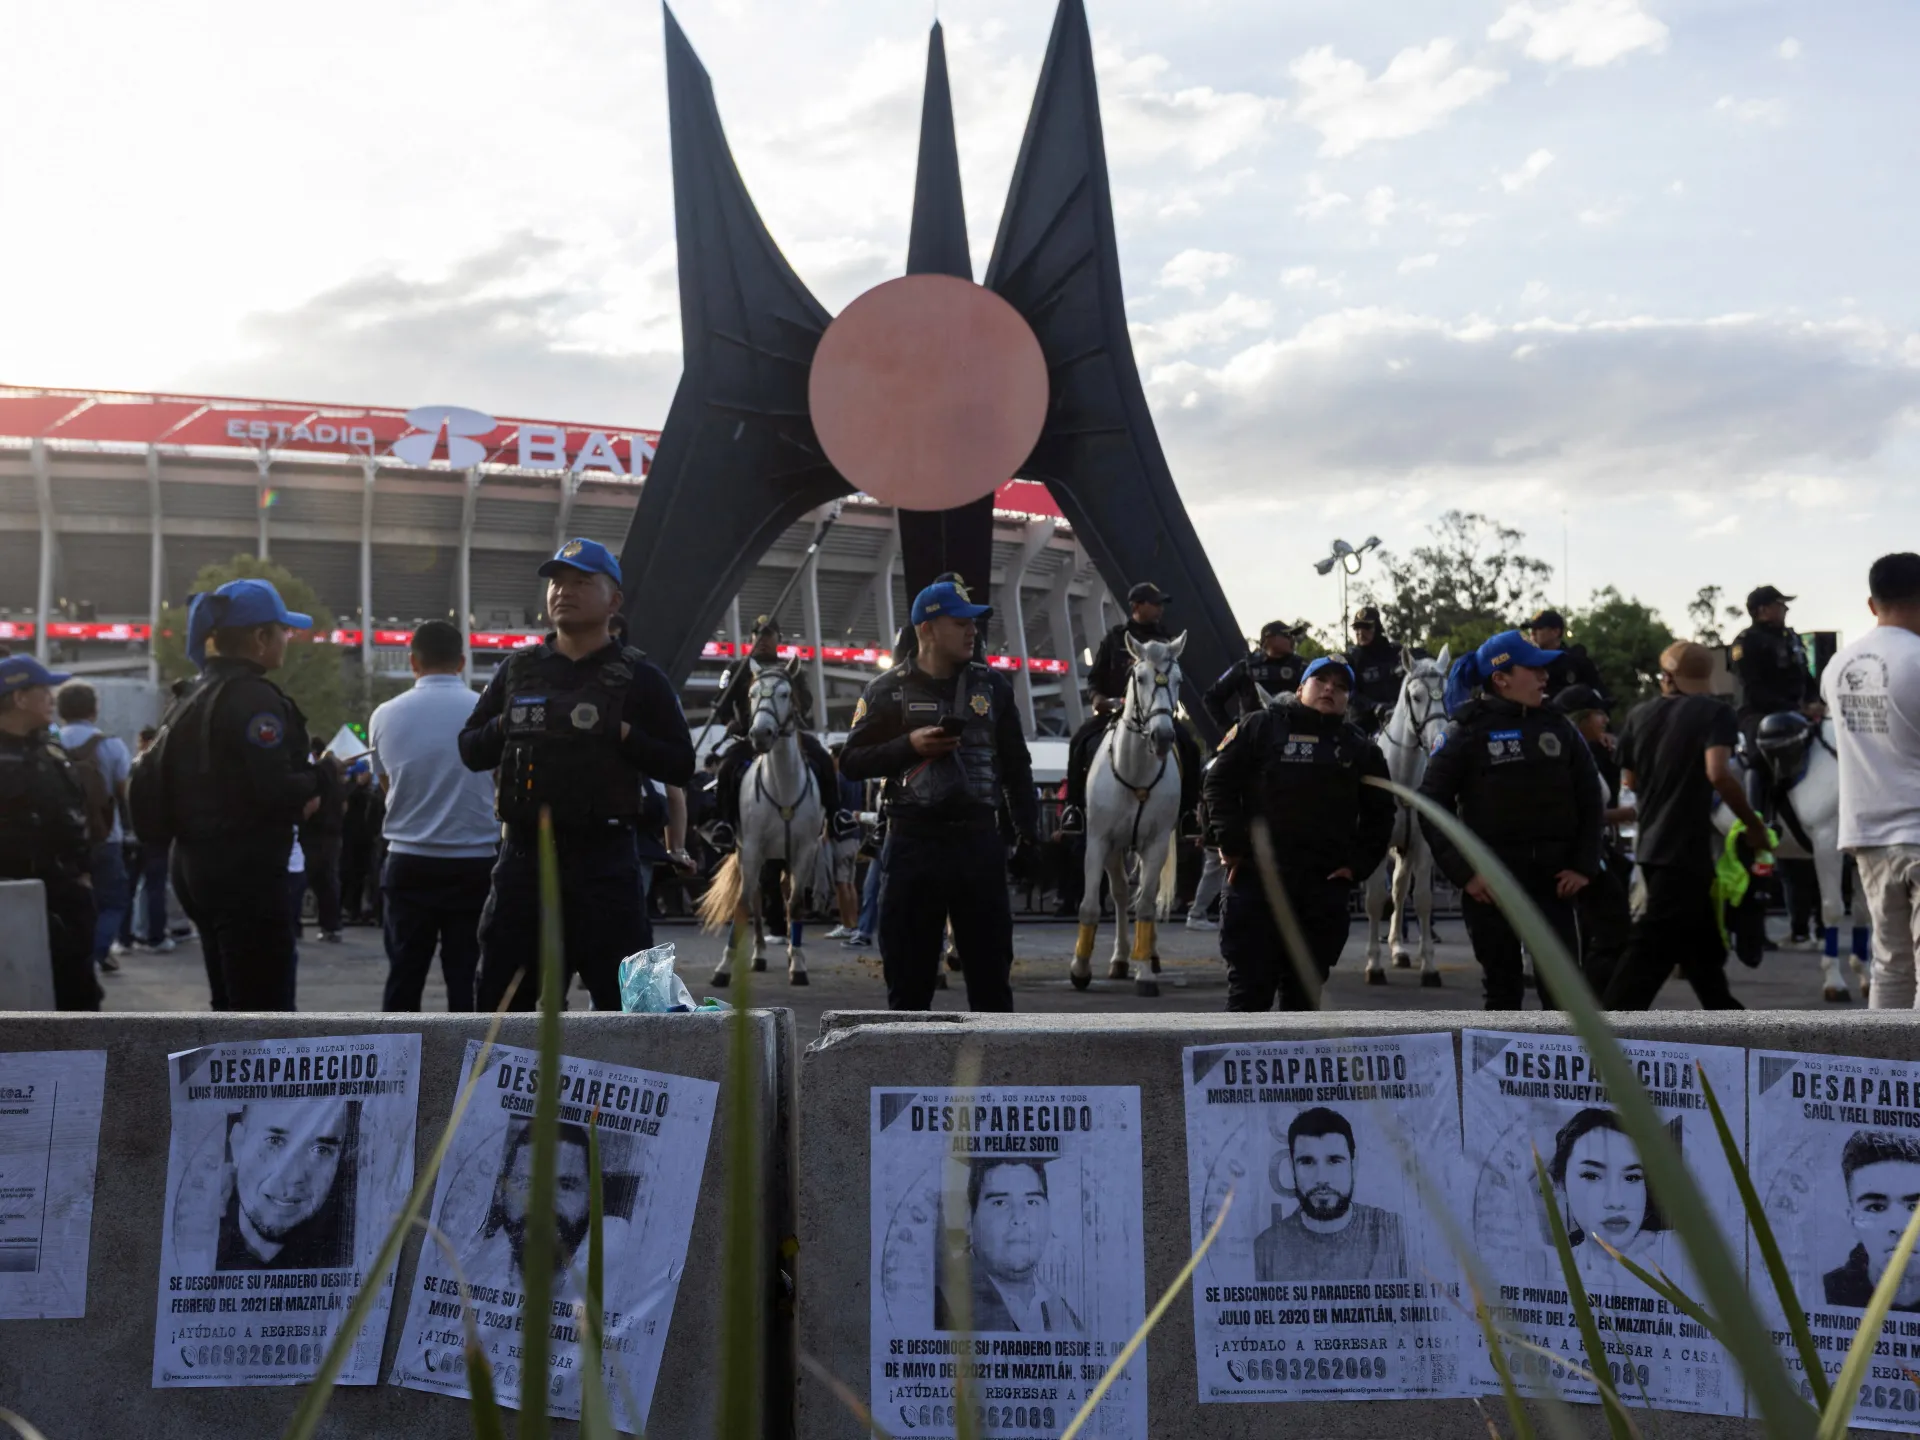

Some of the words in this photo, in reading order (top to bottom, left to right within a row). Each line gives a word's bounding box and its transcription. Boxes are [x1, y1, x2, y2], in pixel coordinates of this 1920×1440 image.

[226, 418, 375, 447] ESTADIO
[221, 1048, 236, 1057] NOS
[243, 1047, 271, 1056] FALTAS
[296, 1046, 310, 1054] NOS
[316, 1045, 345, 1053] FALTAN
[350, 1043, 375, 1051] TODOS
[1257, 1048, 1288, 1056] FALTAS
[1315, 1046, 1332, 1054] NOS
[1336, 1045, 1368, 1054] FALTAN
[1373, 1044, 1400, 1052] TODOS
[1516, 1041, 1534, 1049] NOS
[1539, 1042, 1573, 1052] FALTAS
[1662, 1050, 1690, 1060] TODOS
[210, 1054, 378, 1083] DESAPARECIDO
[514, 1056, 529, 1064] NOS
[588, 1068, 603, 1078] NOS
[608, 1072, 639, 1084] FALTAN
[642, 1078, 669, 1089] TODOS
[1224, 1055, 1408, 1086] DESAPARECIDO
[1505, 1051, 1694, 1090] DESAPACIDA
[1804, 1062, 1822, 1070] NOS
[1828, 1064, 1862, 1074] FALTAS
[188, 1086, 210, 1100] LUIS
[214, 1084, 268, 1099] HUMBERTO
[271, 1083, 336, 1098] VALDELAMAR
[338, 1080, 404, 1097] BUSTAMANTE
[497, 1064, 670, 1118] DESPARECIDO
[1002, 1094, 1018, 1102] NOS
[1024, 1094, 1056, 1102] FALTAN
[1060, 1094, 1088, 1102] TODOS
[1207, 1086, 1256, 1105] MISRAEL
[1259, 1086, 1314, 1104] ARMANDO
[1316, 1083, 1378, 1102] SEPÚLVEDA
[1500, 1079, 1550, 1099] YAJAIRA
[1553, 1084, 1590, 1102] SUJEY
[1645, 1089, 1708, 1110] ERNÁNDEZ
[500, 1093, 534, 1114] CÉSAR
[584, 1108, 631, 1132] BRTOLDI
[632, 1118, 660, 1137] PÁEZ
[911, 1106, 1093, 1132] DESAPARECIDO
[1803, 1100, 1835, 1121] SAÚL
[1838, 1104, 1870, 1124] YAEL
[952, 1136, 980, 1152] ALEX
[984, 1132, 1026, 1153] PELÁEZ
[1030, 1136, 1058, 1152] SOTO
[169, 1277, 182, 1291] SE
[185, 1276, 245, 1291] DESCONOCE
[247, 1276, 261, 1290] SU
[263, 1274, 318, 1290] PARADERO
[424, 1276, 438, 1292] SE
[501, 1291, 516, 1308] SU
[1206, 1287, 1220, 1303] SE
[1223, 1286, 1290, 1302] DESCONOCE
[1293, 1285, 1308, 1302] SU
[1310, 1284, 1371, 1300] PARADERO
[1374, 1283, 1410, 1300] DESDE
[171, 1298, 216, 1313] FEBRERO
[219, 1298, 237, 1312] DEL
[240, 1297, 268, 1312] 2021
[269, 1297, 282, 1312] EN
[285, 1292, 344, 1311] MAZATLÁN,
[1500, 1286, 1520, 1301] FUE
[1523, 1288, 1568, 1306] PRIVADA
[1588, 1293, 1602, 1308] SU
[1605, 1294, 1654, 1313] LIBERTAD
[1658, 1300, 1670, 1314] EL
[428, 1300, 461, 1320] MAYO
[484, 1310, 513, 1332] 2023
[1218, 1309, 1250, 1325] JULIO
[1254, 1308, 1276, 1324] DEL
[1278, 1308, 1310, 1324] 2020
[1313, 1308, 1328, 1324] EN
[1331, 1304, 1397, 1325] MAZATLÁN,
[1546, 1310, 1565, 1326] DEL
[1615, 1317, 1676, 1338] MAZATLÁN,
[172, 1324, 236, 1344] ¡AYÚDALO
[244, 1328, 252, 1338] A
[261, 1325, 327, 1338] REGRESAR
[1882, 1320, 1896, 1334] SU
[197, 1344, 324, 1366] 6693262089
[418, 1329, 466, 1348] ¡AYÚDA
[492, 1342, 499, 1354] A
[508, 1346, 574, 1369] RESAR
[890, 1340, 904, 1355] SE
[975, 1341, 990, 1356] SU
[992, 1340, 1052, 1356] PARADERO
[1055, 1341, 1091, 1356] DESDE
[1214, 1336, 1286, 1358] ¡AYÚDALO
[1296, 1340, 1304, 1351] A
[1314, 1339, 1388, 1351] REGRESAR
[1396, 1339, 1406, 1349] A
[1560, 1338, 1570, 1350] A
[1662, 1348, 1672, 1360] A
[1894, 1342, 1907, 1358] EN
[885, 1363, 900, 1378] DE
[902, 1362, 936, 1379] MAYO
[939, 1364, 957, 1380] DEL
[994, 1364, 1009, 1380] EN
[1012, 1361, 1076, 1382] MAZATLÁN,
[1248, 1357, 1387, 1381] 6693262089
[1509, 1352, 1650, 1386] 669326089
[985, 1388, 1058, 1400] REGRESAR
[1066, 1388, 1076, 1400] A
[919, 1404, 1057, 1430] 669262089
